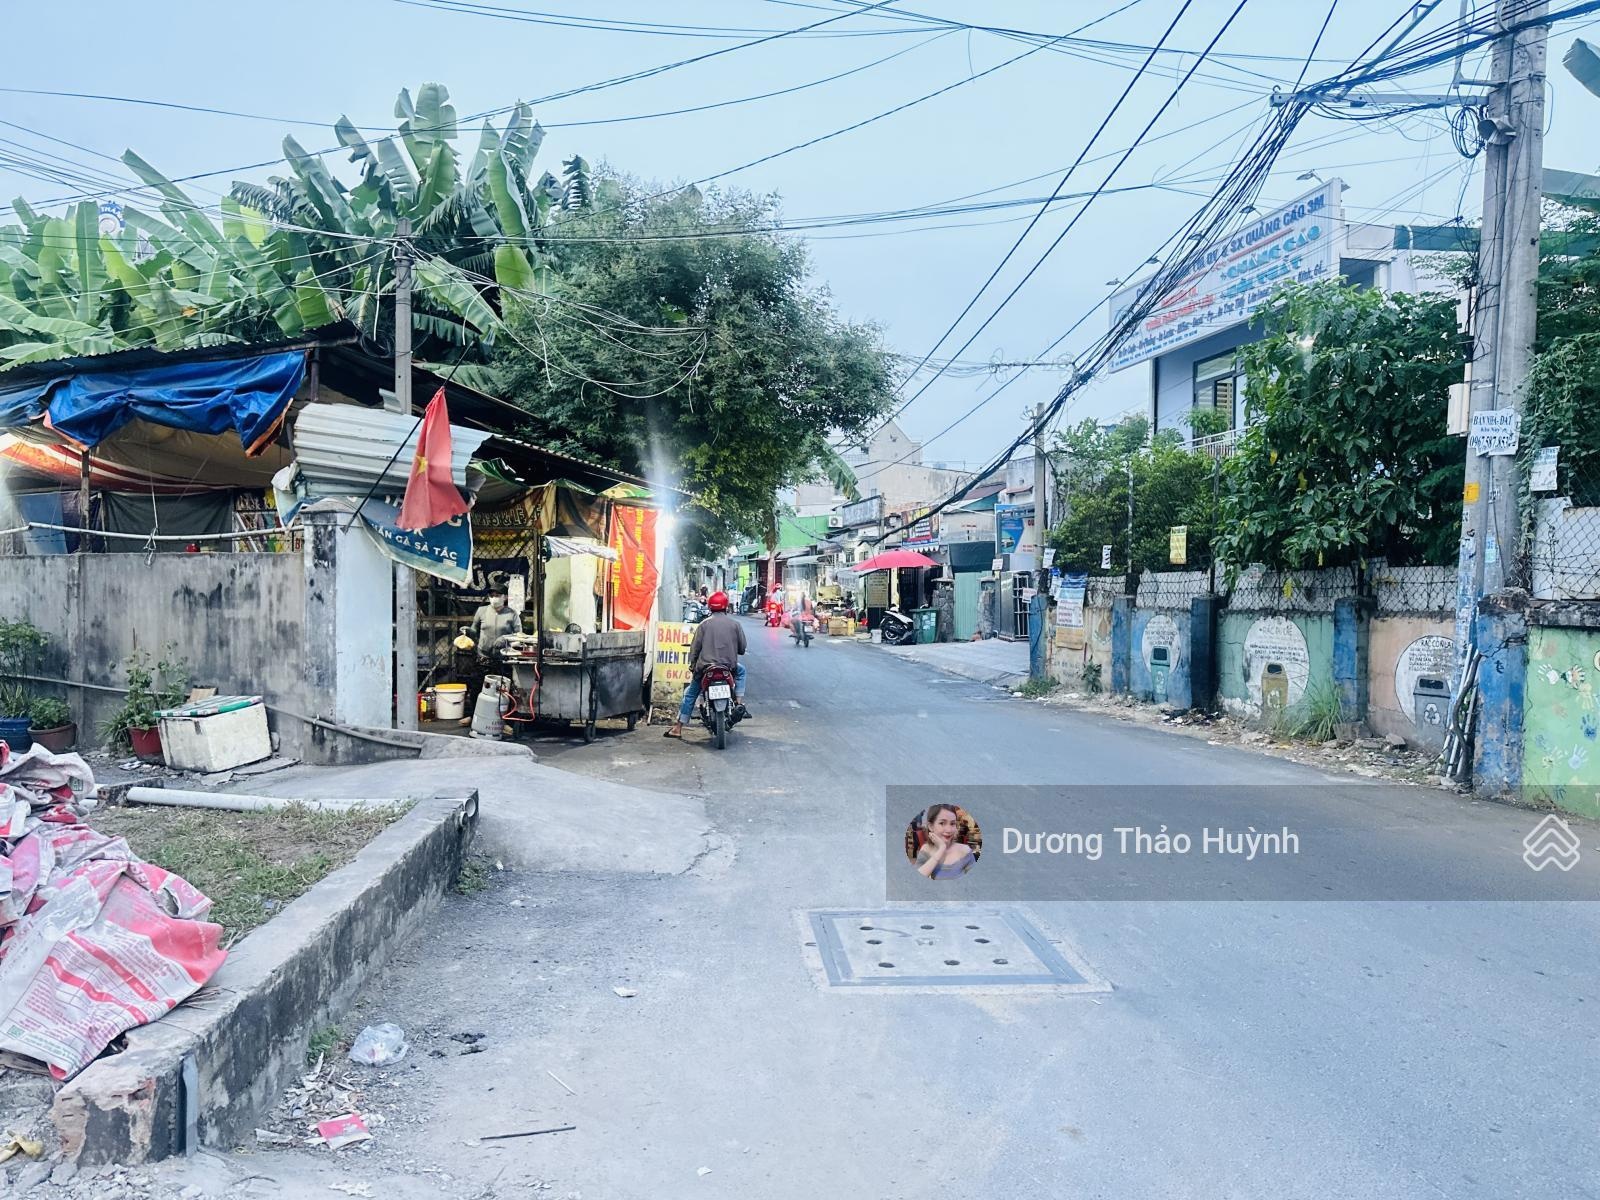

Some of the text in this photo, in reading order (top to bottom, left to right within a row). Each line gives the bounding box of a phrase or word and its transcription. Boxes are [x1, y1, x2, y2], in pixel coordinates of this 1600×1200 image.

[1245, 216, 1280, 246] QUẢNG
[1283, 204, 1305, 226] CÁO
[1307, 194, 1325, 214] 3M
[395, 534, 411, 547] GÀ
[414, 541, 429, 553] SẢ
